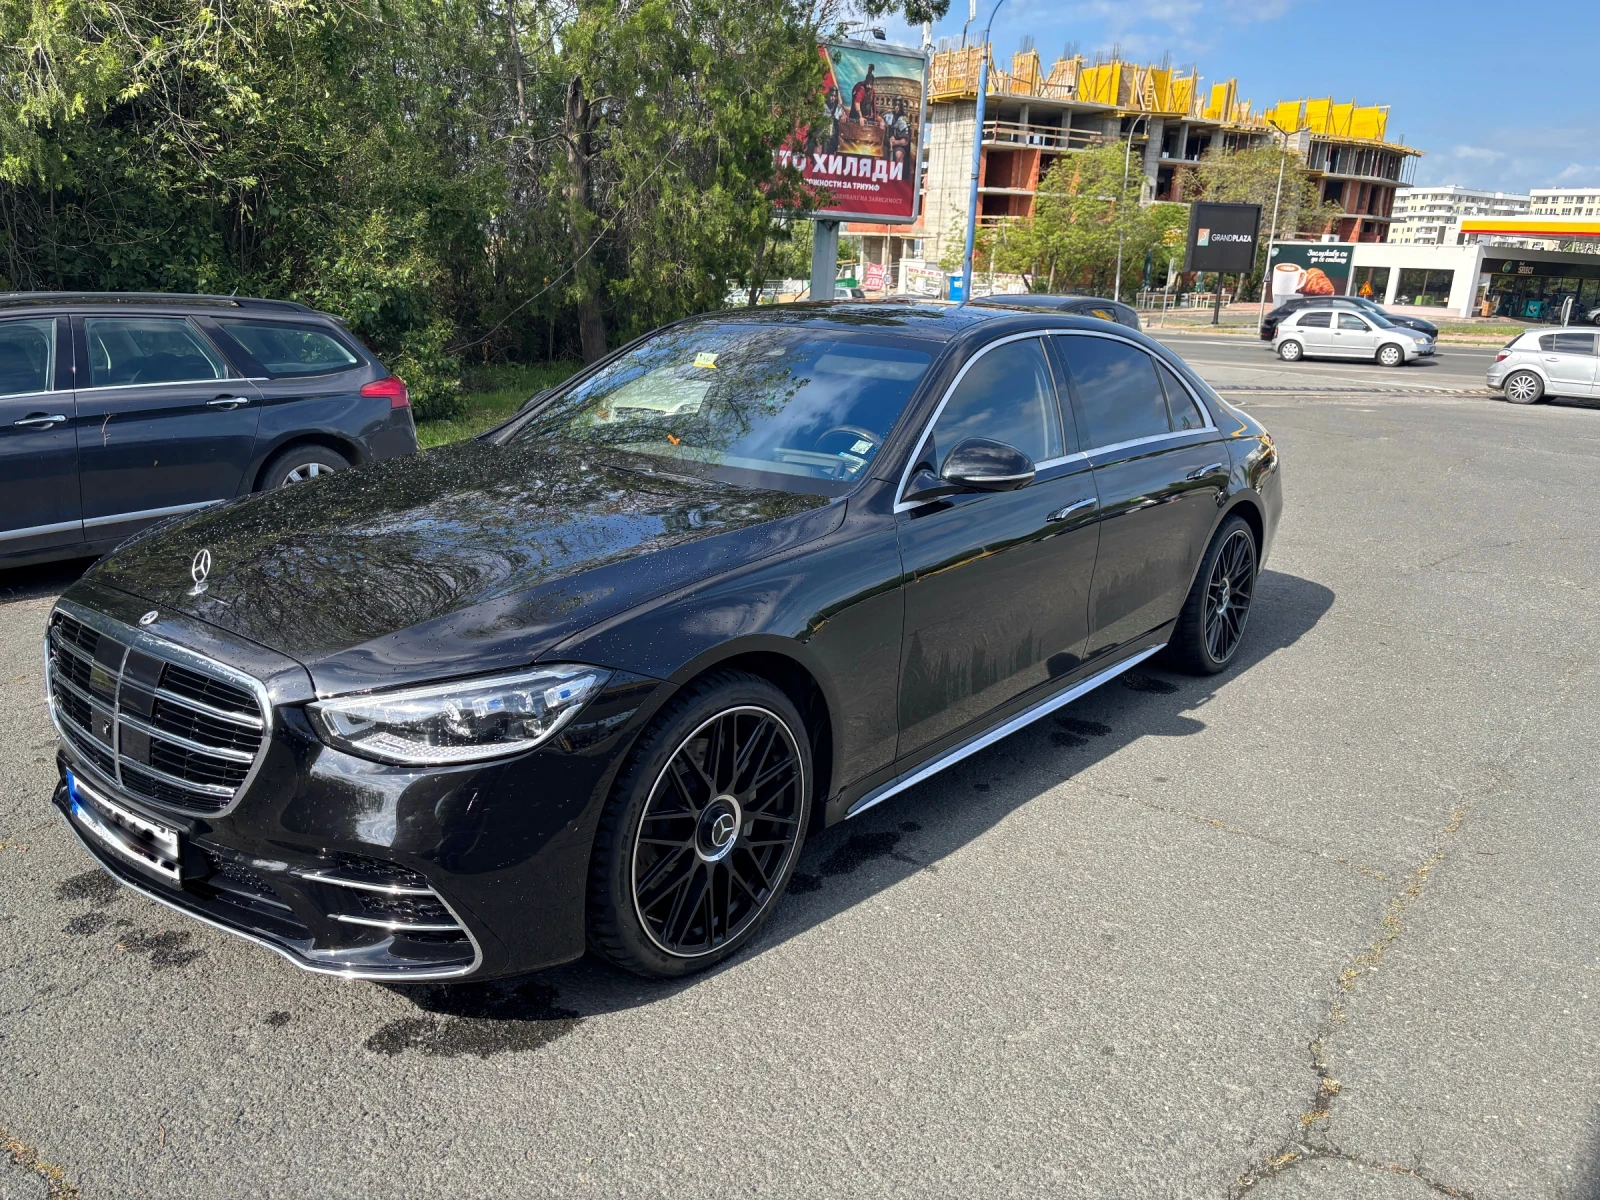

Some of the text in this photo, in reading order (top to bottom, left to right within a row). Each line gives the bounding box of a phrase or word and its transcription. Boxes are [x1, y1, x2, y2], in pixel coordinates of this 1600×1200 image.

[812, 153, 904, 183] ХИЛЯДИ
[852, 182, 880, 192] ТРИУМФ
[868, 195, 903, 205] ЗАВИСИМОСТ
[1517, 266, 1534, 274] SELECT
